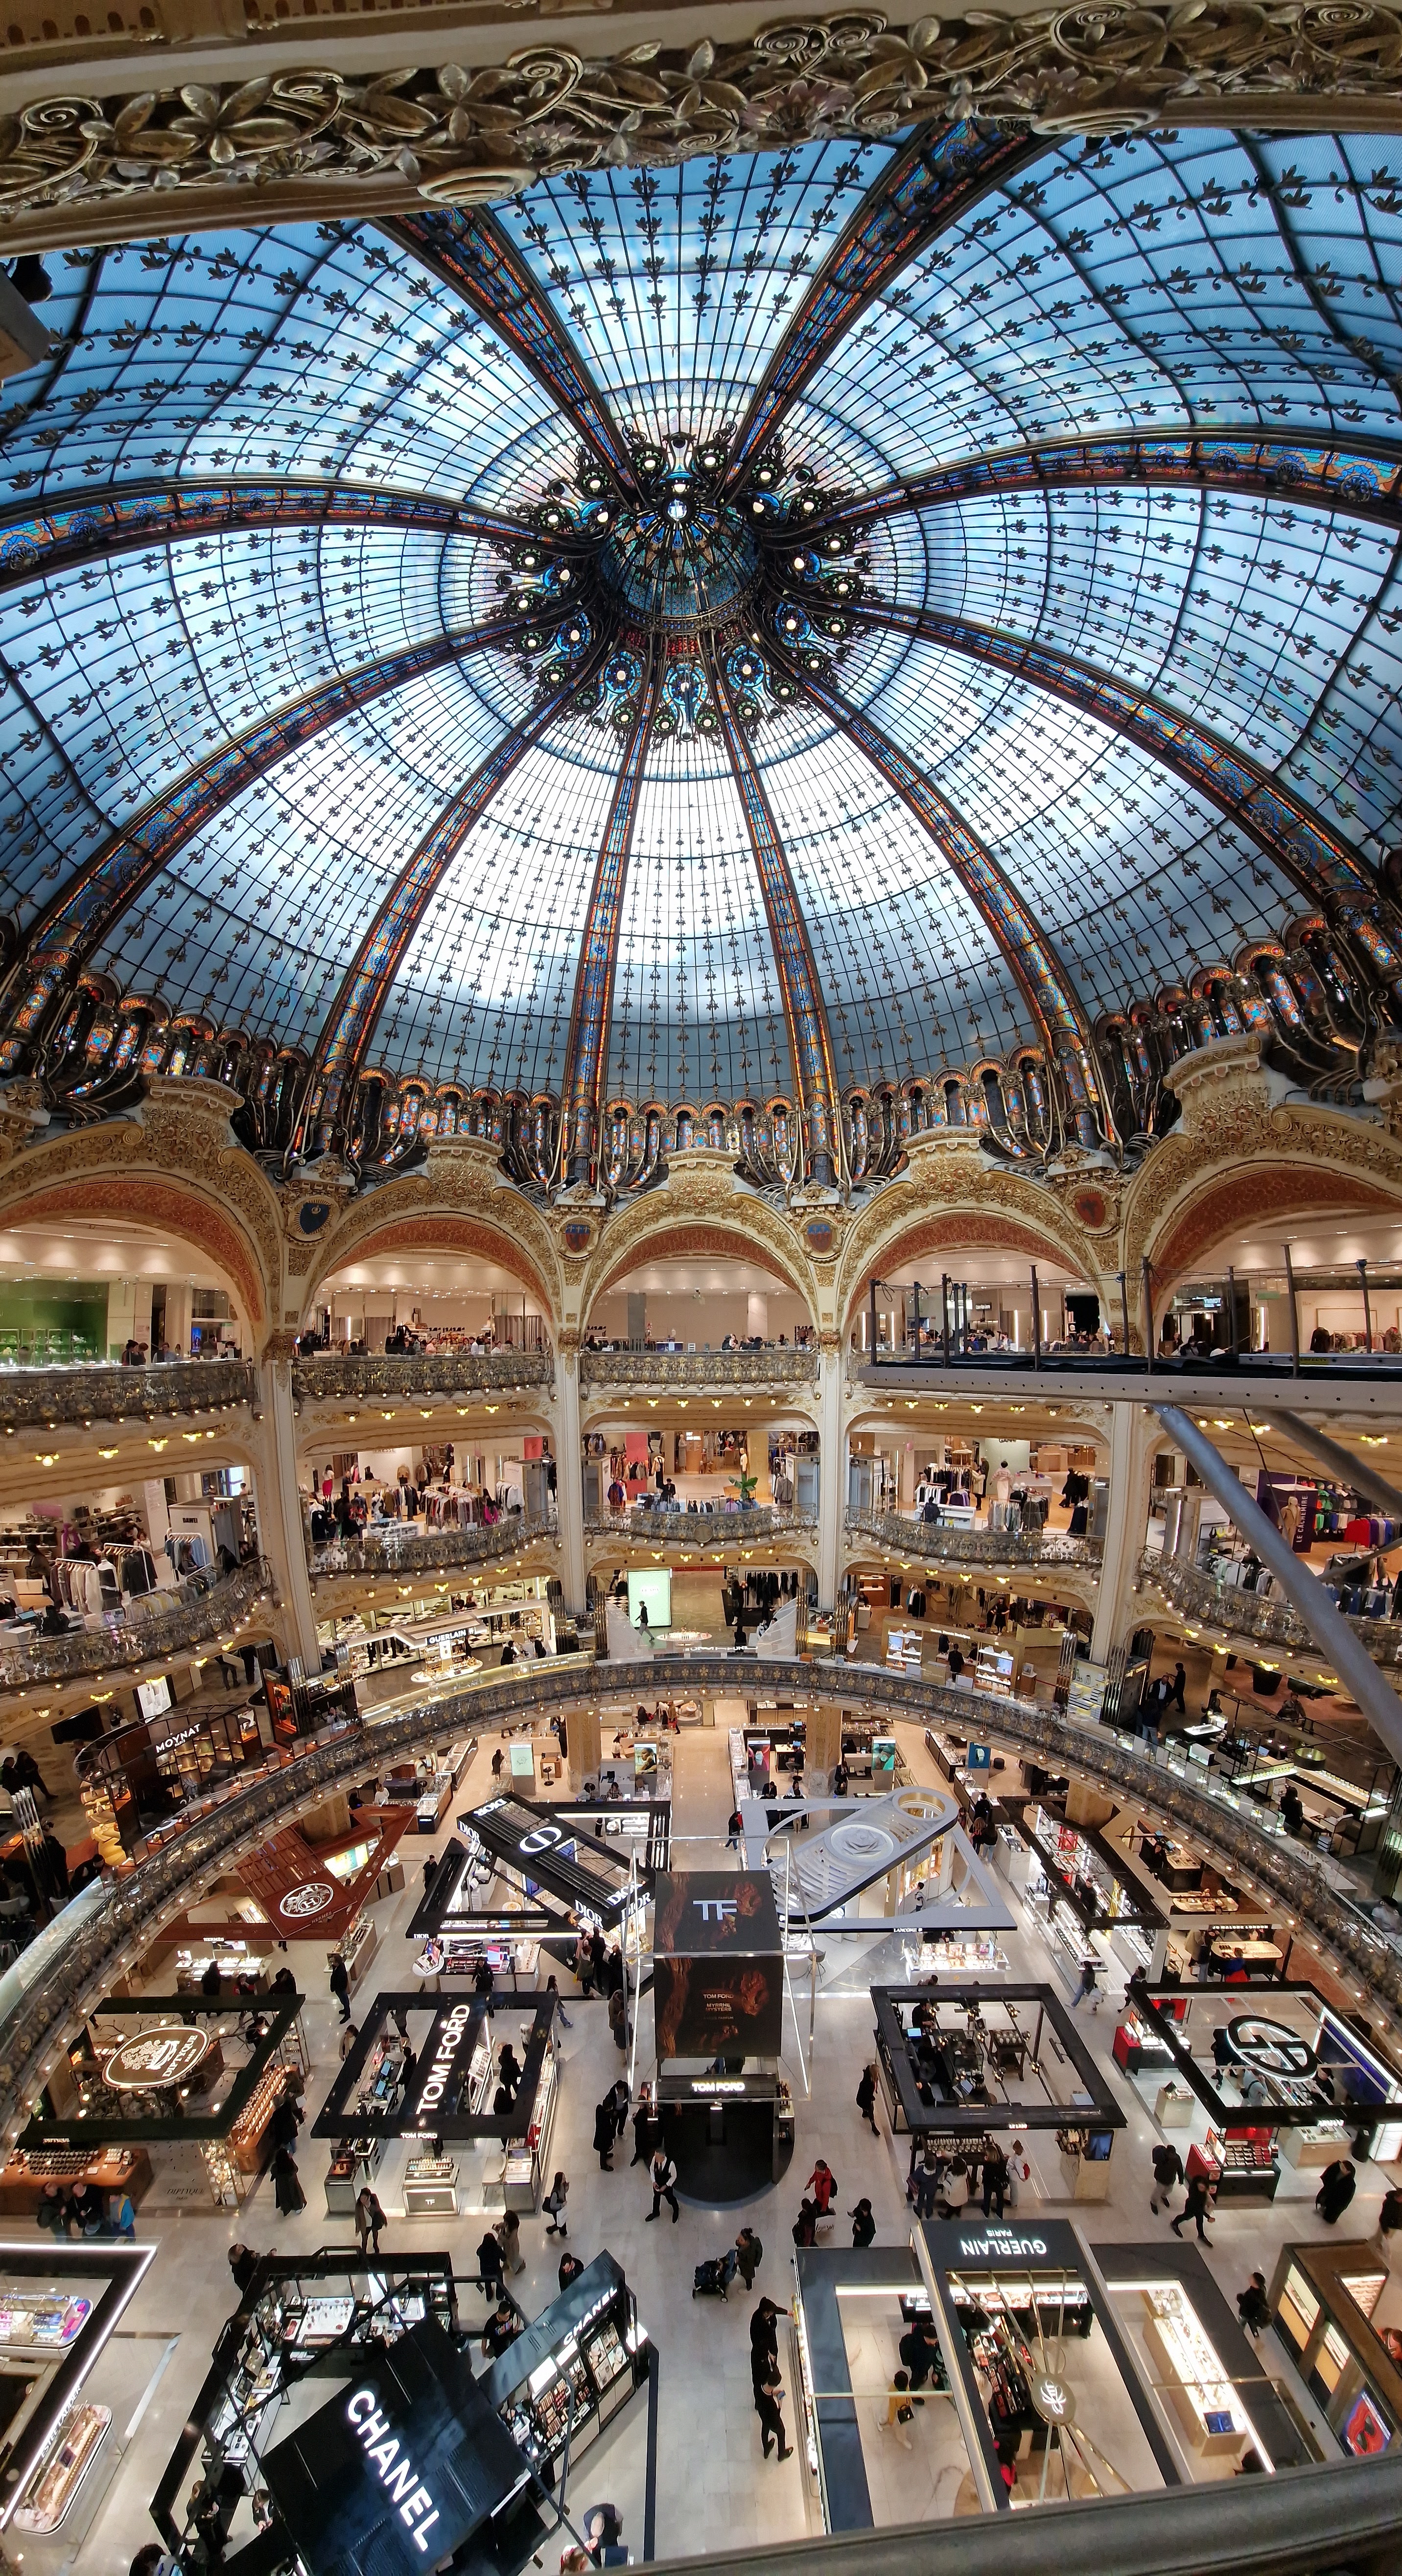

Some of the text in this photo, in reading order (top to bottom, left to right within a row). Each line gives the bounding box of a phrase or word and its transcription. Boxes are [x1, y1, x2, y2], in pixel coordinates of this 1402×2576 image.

[1297, 1495, 1309, 1533] CACHEMIRE
[429, 1629, 467, 1644] GUERLAIN
[156, 1723, 201, 1753] MOYNAT
[472, 1798, 508, 1817] DIOR
[459, 1820, 481, 1844] DIOR
[575, 1899, 604, 1929] DIOR
[693, 1899, 737, 1921] TF
[162, 2035, 198, 2078] DIPTYQUE
[415, 2004, 471, 2115] TOM FORD
[691, 2082, 746, 2092] TOM FORD
[985, 2229, 1013, 2237] PARIS
[960, 2239, 1047, 2255] GUERLAIN
[563, 2286, 618, 2346] CHANEL
[347, 2390, 440, 2552] CHANEL
